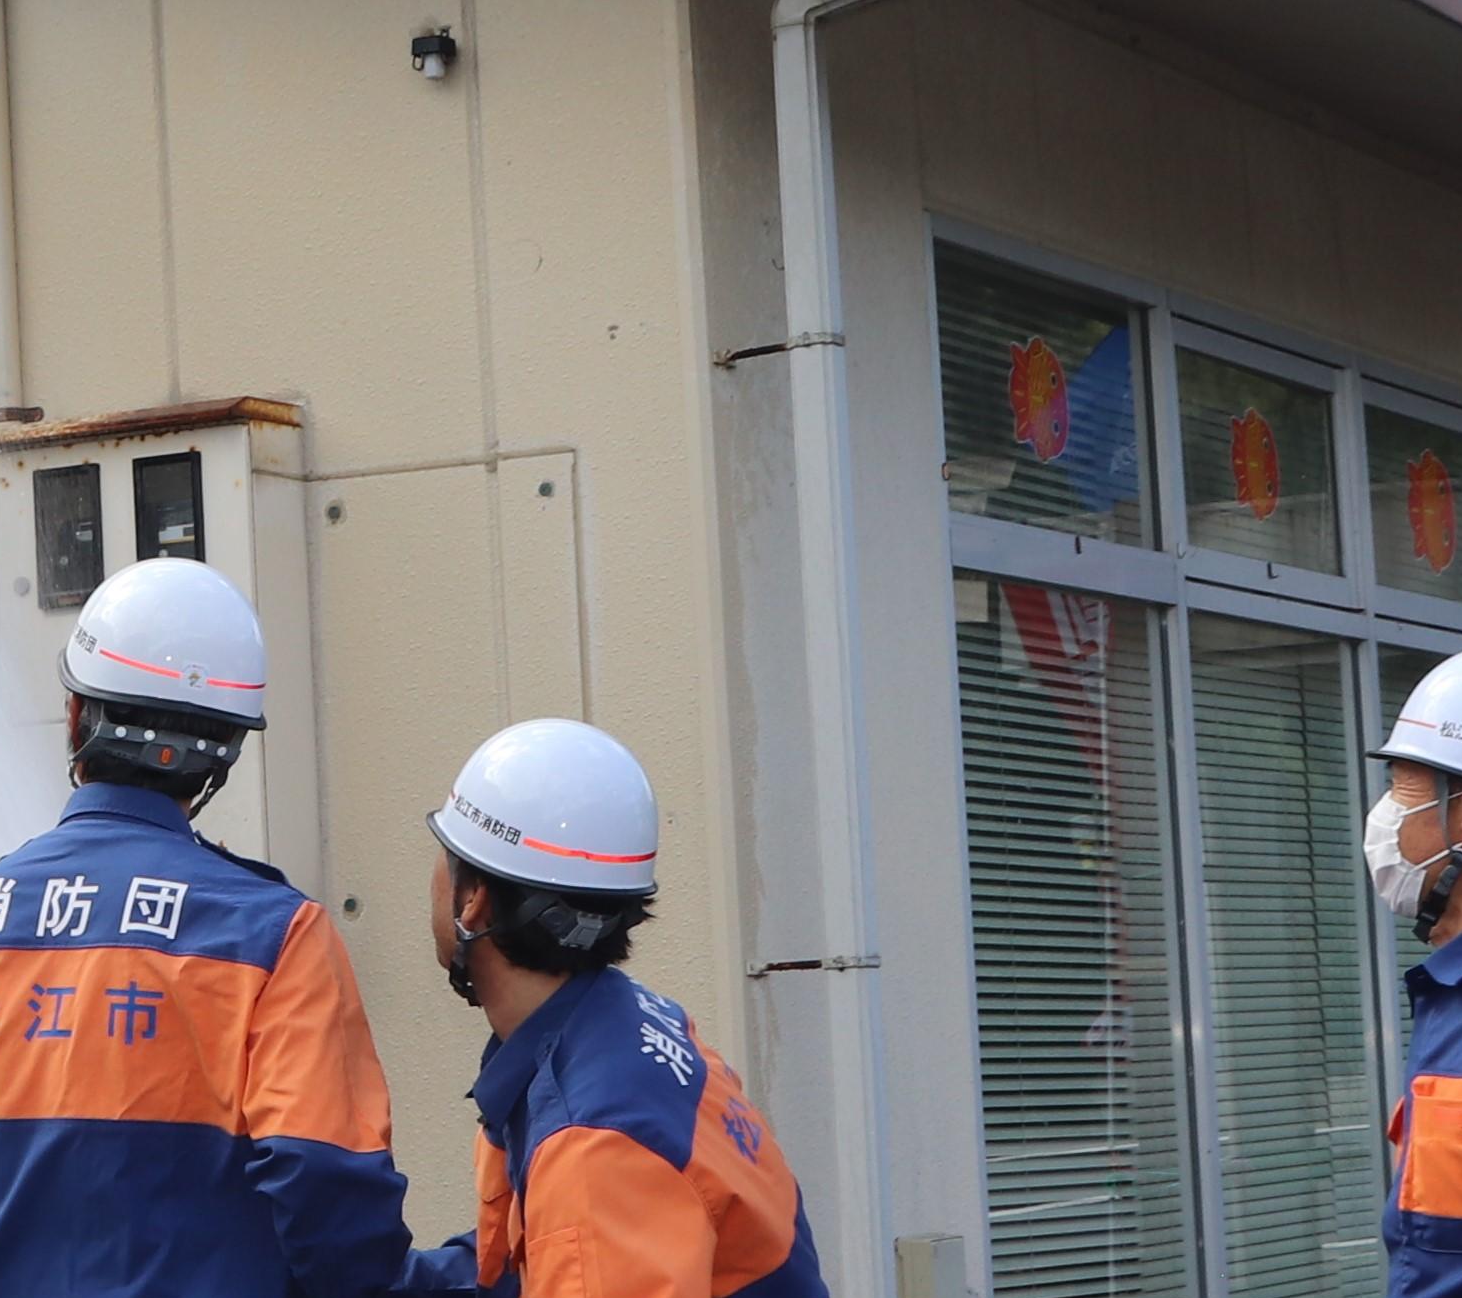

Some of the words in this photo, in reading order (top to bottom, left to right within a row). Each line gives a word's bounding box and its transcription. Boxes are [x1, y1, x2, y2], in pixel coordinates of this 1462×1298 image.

[454, 795, 522, 845] 松江市消防団
